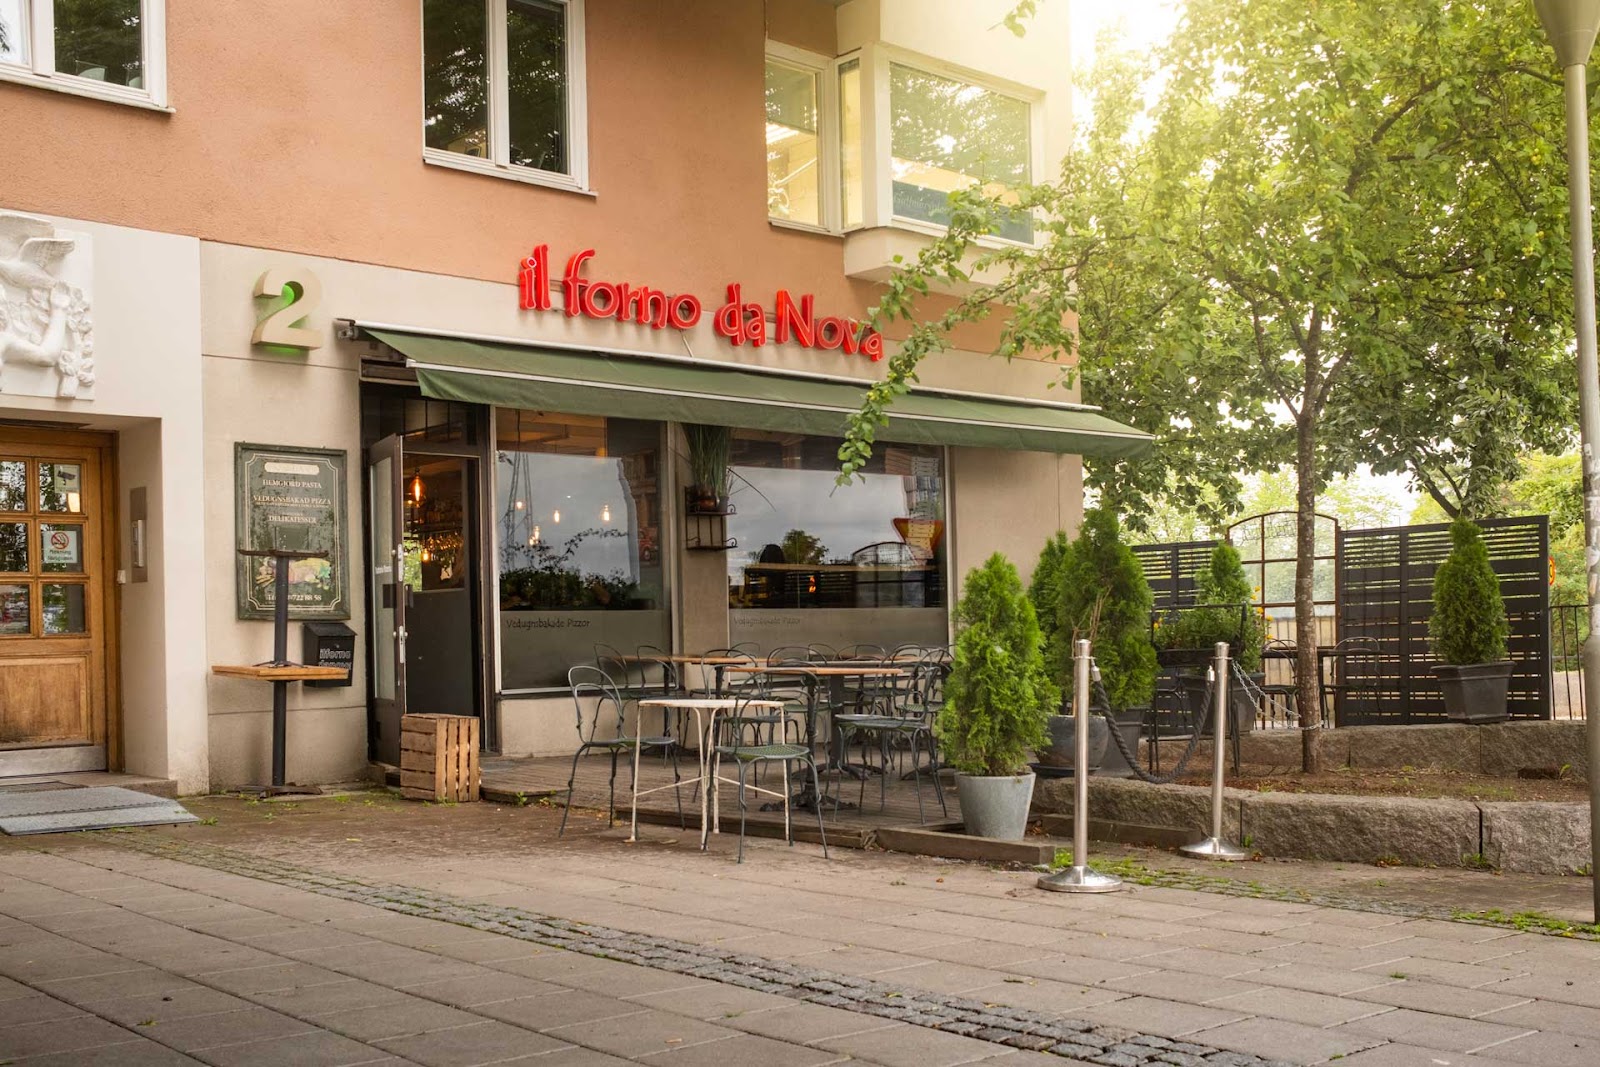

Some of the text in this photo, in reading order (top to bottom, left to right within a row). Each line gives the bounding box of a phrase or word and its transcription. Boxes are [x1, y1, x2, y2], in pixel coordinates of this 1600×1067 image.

[250, 264, 324, 351] 2
[519, 244, 884, 362] il forno da Nova
[302, 481, 323, 489] PASTA
[311, 497, 332, 505] PIZZA
[506, 618, 591, 631] Vedugnsbakade Pizzor
